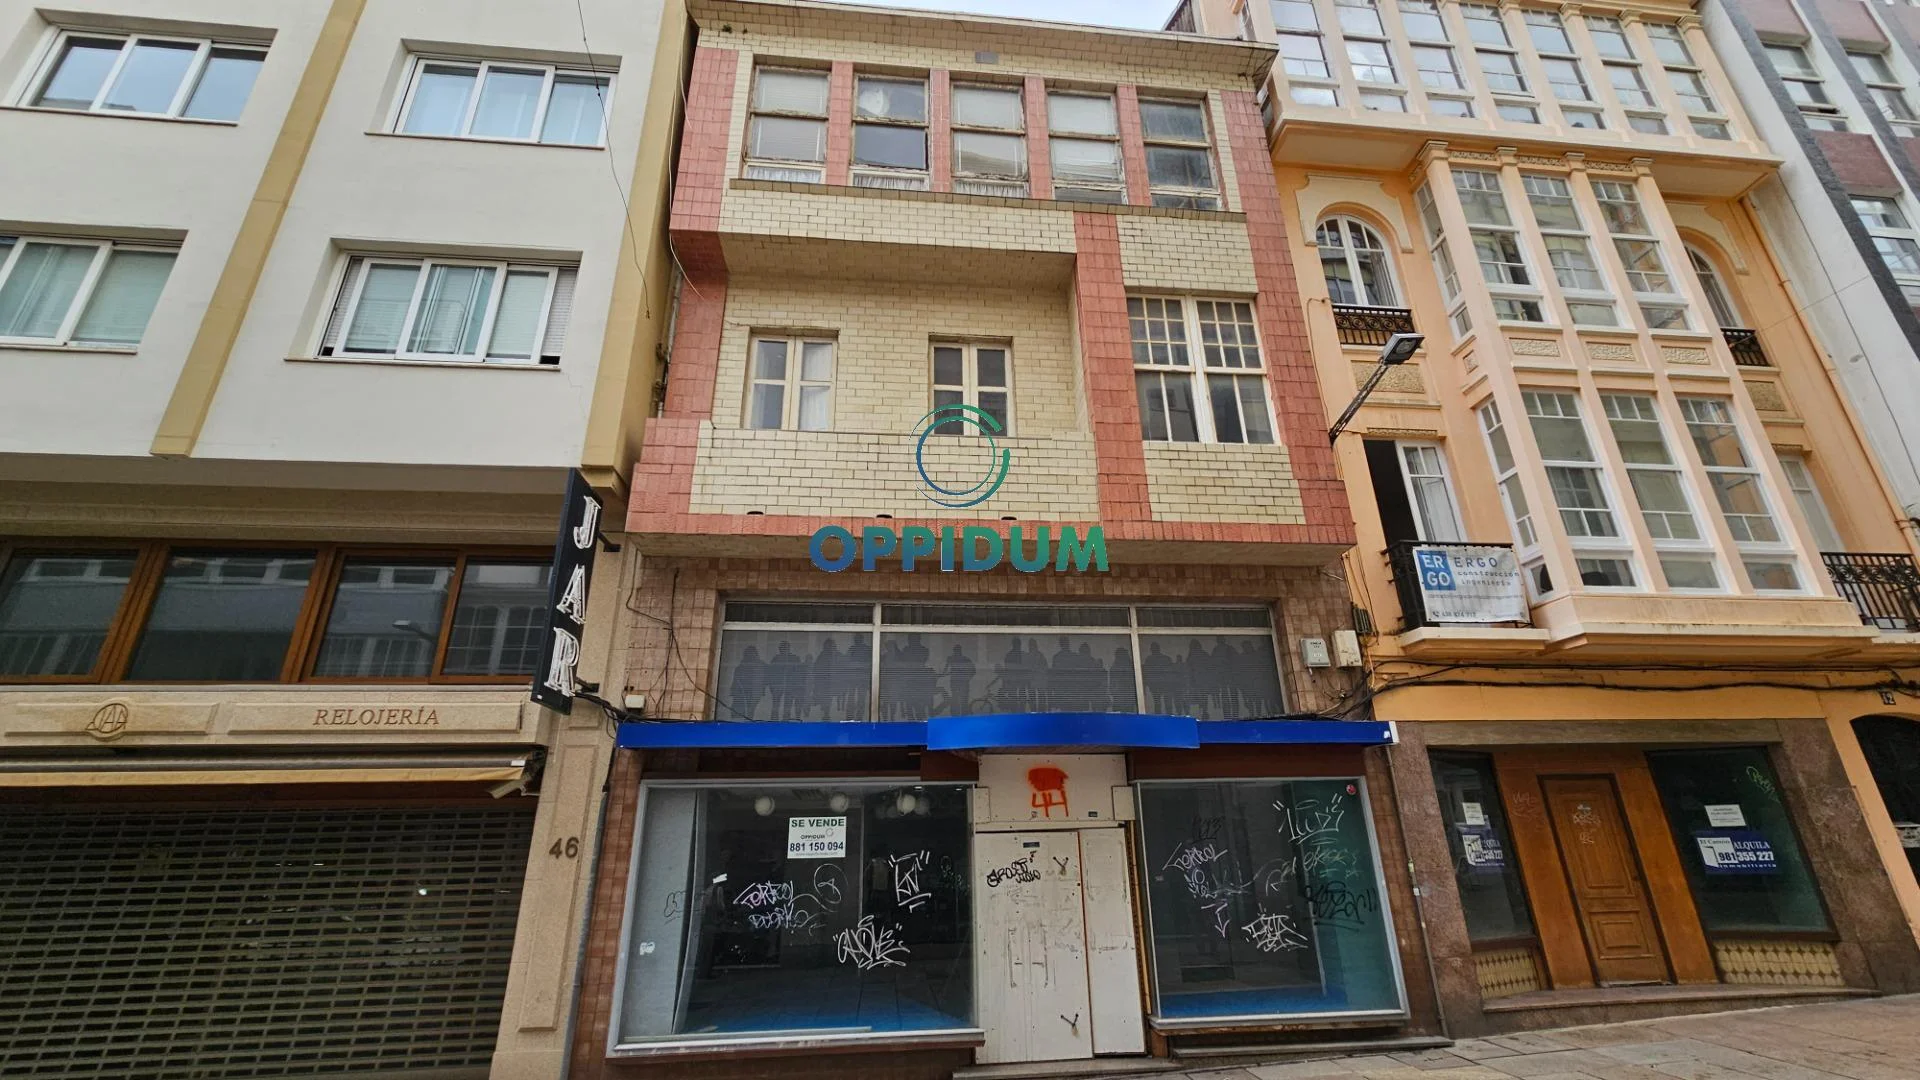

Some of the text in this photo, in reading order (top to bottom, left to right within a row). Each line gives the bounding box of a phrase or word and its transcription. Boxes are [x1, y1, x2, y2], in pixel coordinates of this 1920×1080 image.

[1421, 554, 1445, 569] ER
[1454, 556, 1498, 568] ERGO
[1427, 571, 1450, 586] GO
[543, 495, 601, 698] JAR
[312, 704, 441, 727] RELOJERÍA
[791, 818, 845, 828] SE VENDE
[549, 836, 580, 859] 46
[789, 841, 844, 852] 881 150 094
[1733, 841, 1771, 850] ALQUILA
[1718, 850, 1775, 862] 981 355 227
